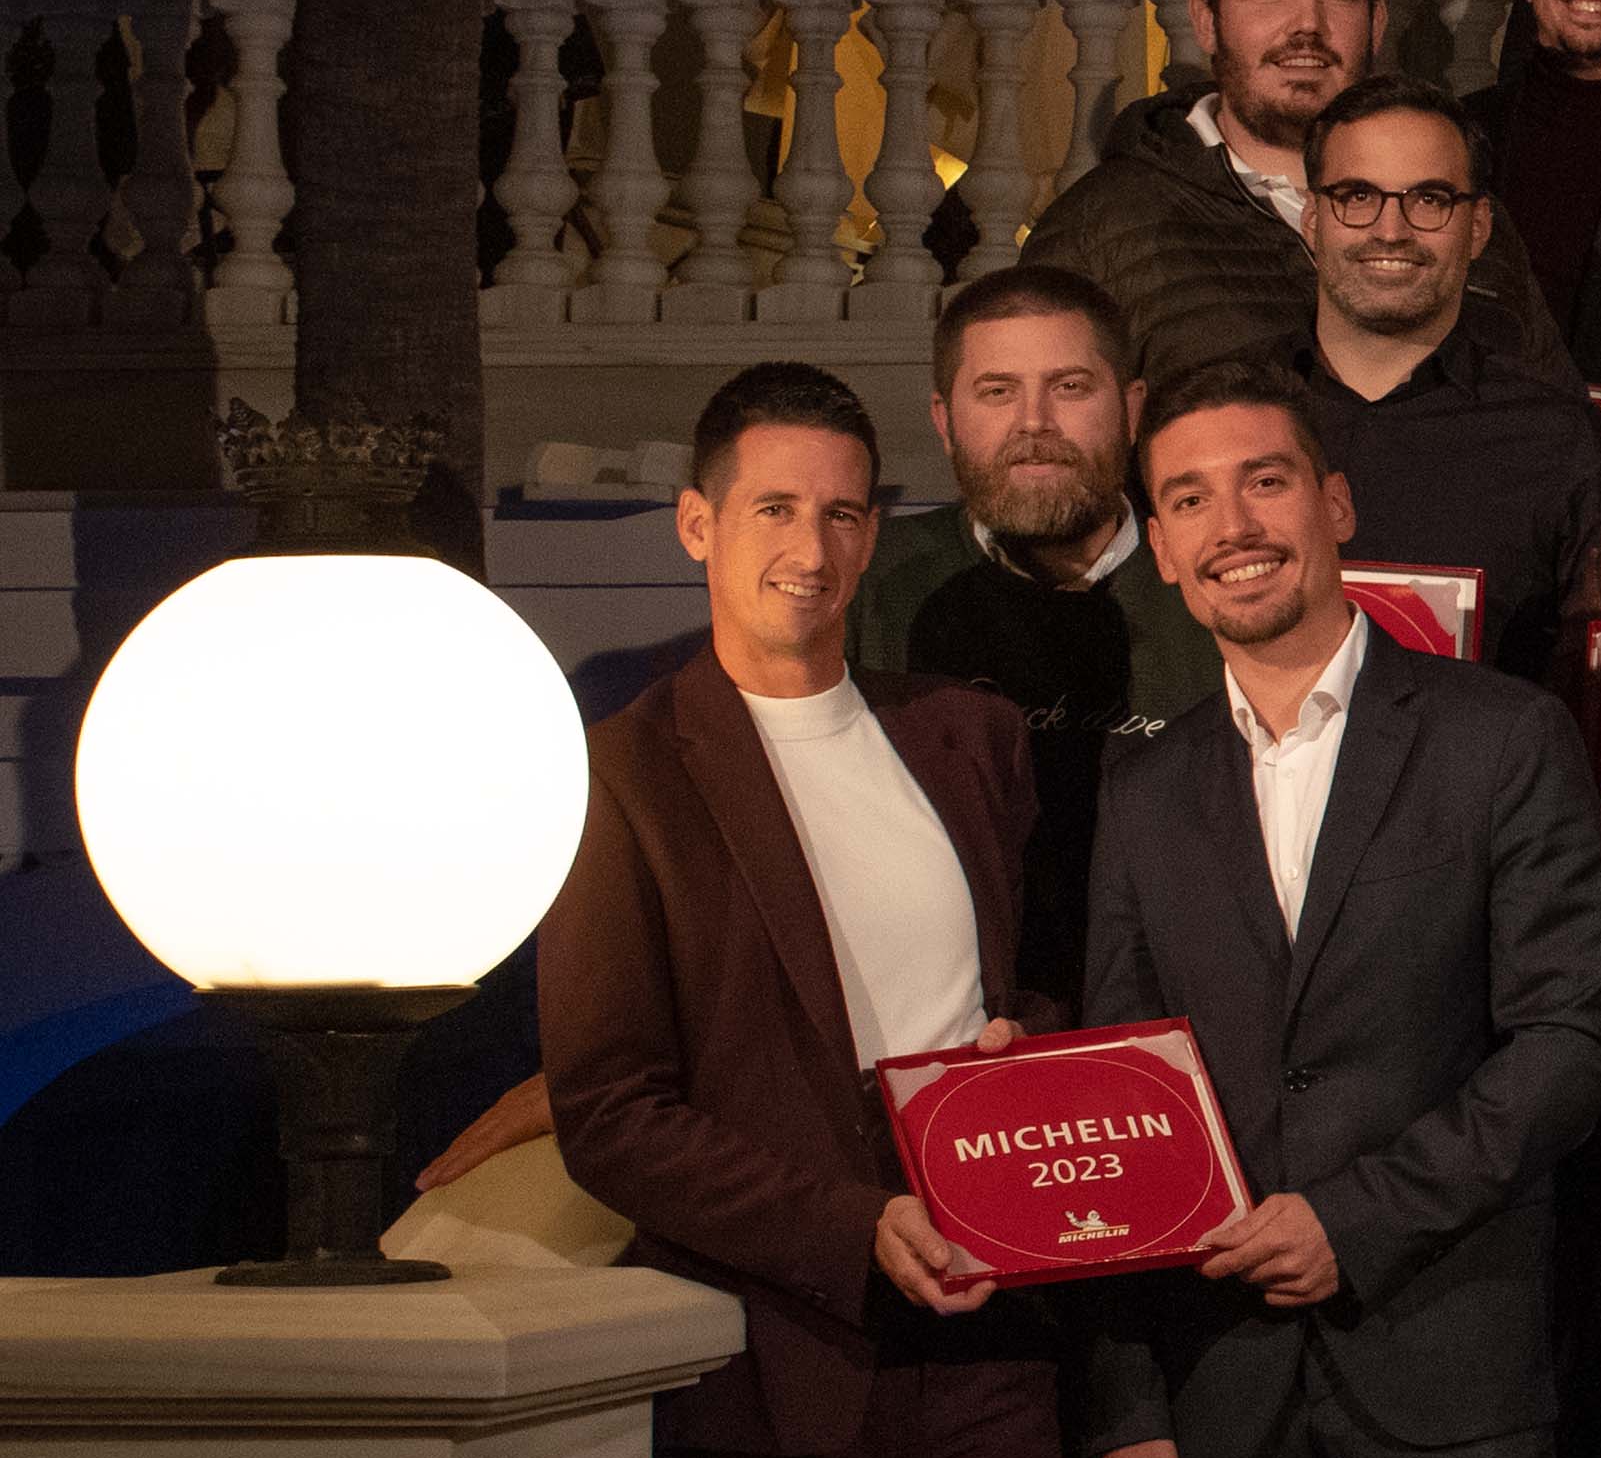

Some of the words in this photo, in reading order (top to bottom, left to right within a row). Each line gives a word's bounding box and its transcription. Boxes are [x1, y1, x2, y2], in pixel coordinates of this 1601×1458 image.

[954, 1114, 1172, 1162] MICHELIN
[1028, 1154, 1123, 1187] 2023
[1058, 1227, 1130, 1244] MICHELIN
